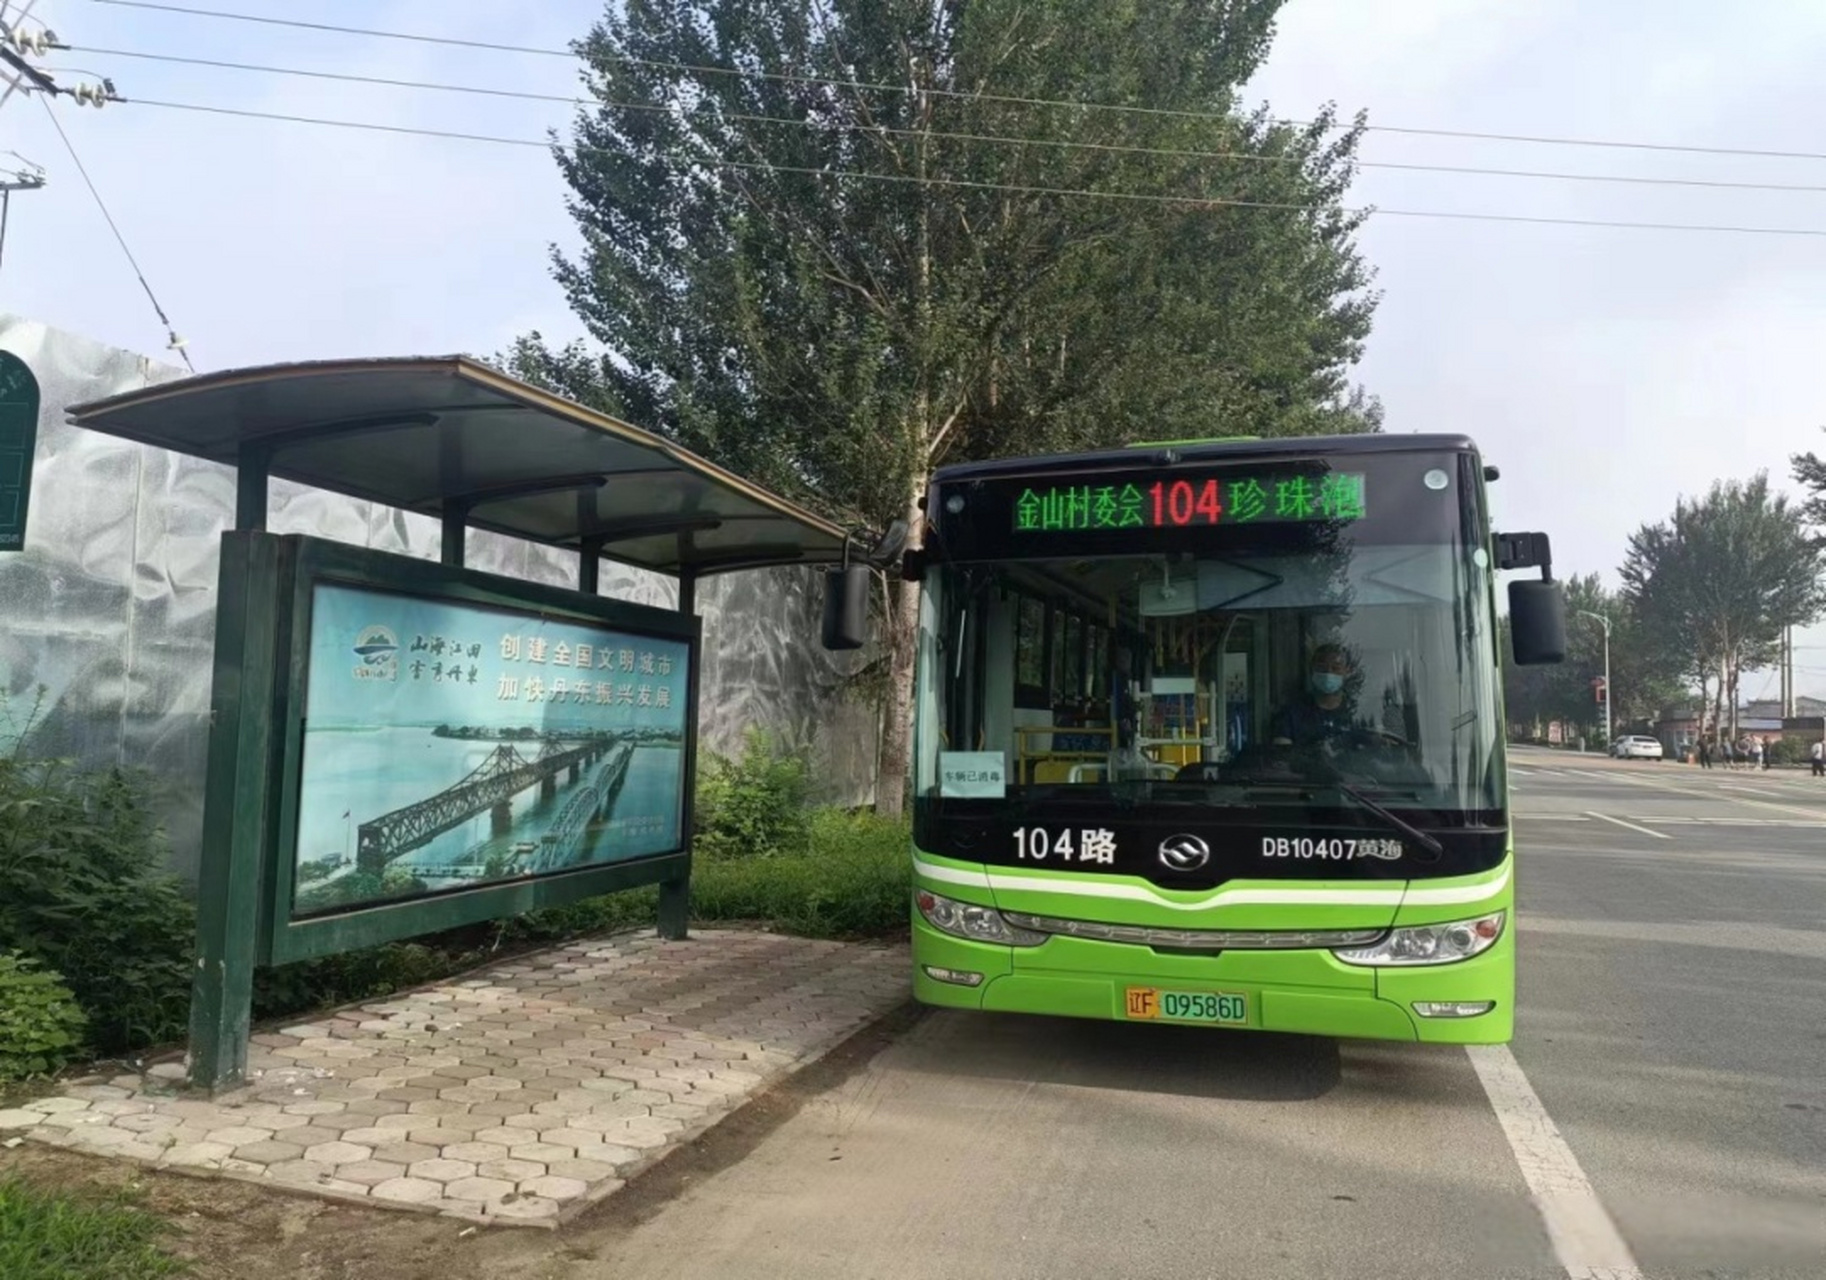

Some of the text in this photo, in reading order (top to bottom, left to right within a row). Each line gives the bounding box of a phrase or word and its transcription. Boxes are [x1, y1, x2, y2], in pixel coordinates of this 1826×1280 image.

[1017, 483, 1143, 530] 金山村委会
[1149, 479, 1221, 526] 104
[500, 633, 673, 675] 创建全国文明城市
[498, 673, 671, 709] 加快丹东振兴发展
[1012, 826, 1117, 864] 104路
[1262, 837, 1357, 860] DB10407
